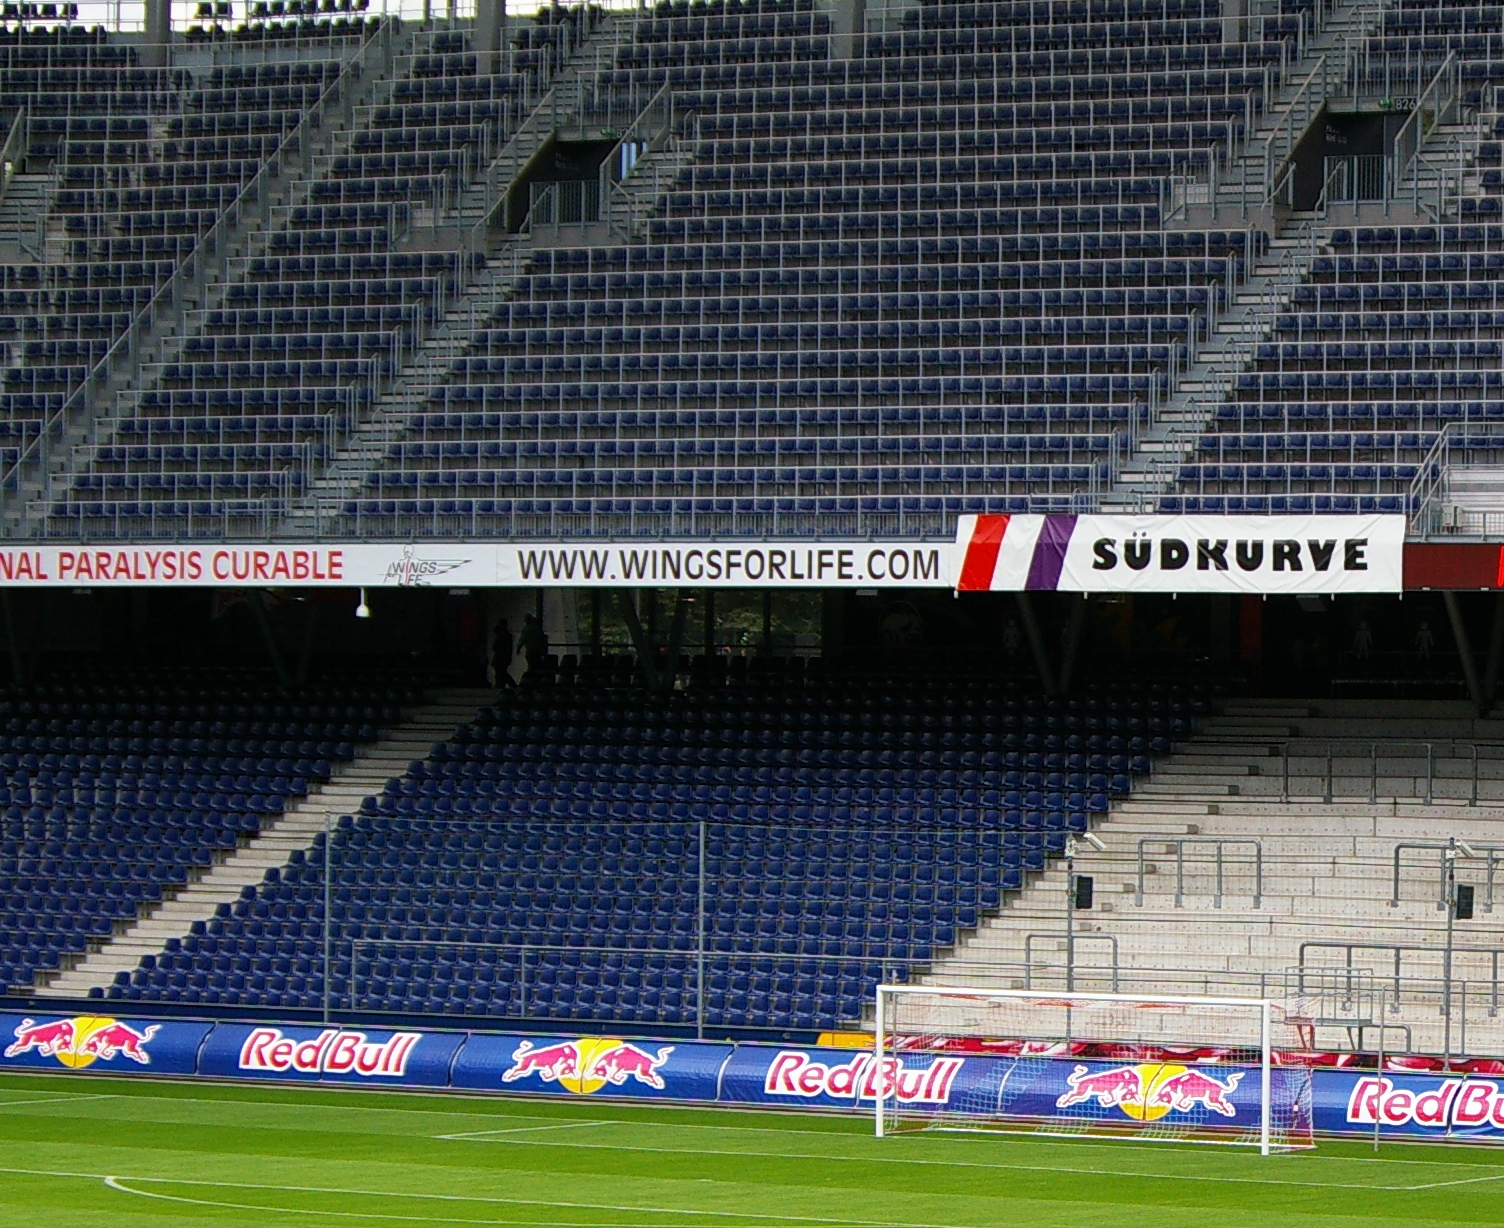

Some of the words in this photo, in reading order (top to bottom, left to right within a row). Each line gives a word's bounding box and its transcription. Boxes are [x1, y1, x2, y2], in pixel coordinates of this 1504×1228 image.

[58, 551, 203, 580] PARALYSIS
[212, 550, 343, 580] CURABLE
[392, 561, 438, 574] WINGS
[517, 549, 939, 580] WWW.WINGSFORLIFE.COM
[1092, 531, 1368, 572] SÜDKURVE
[241, 1031, 333, 1070] Red
[325, 1034, 416, 1073] Bull
[767, 1054, 867, 1094] Red
[862, 1060, 959, 1100] Bull
[1350, 1080, 1456, 1122] Red
